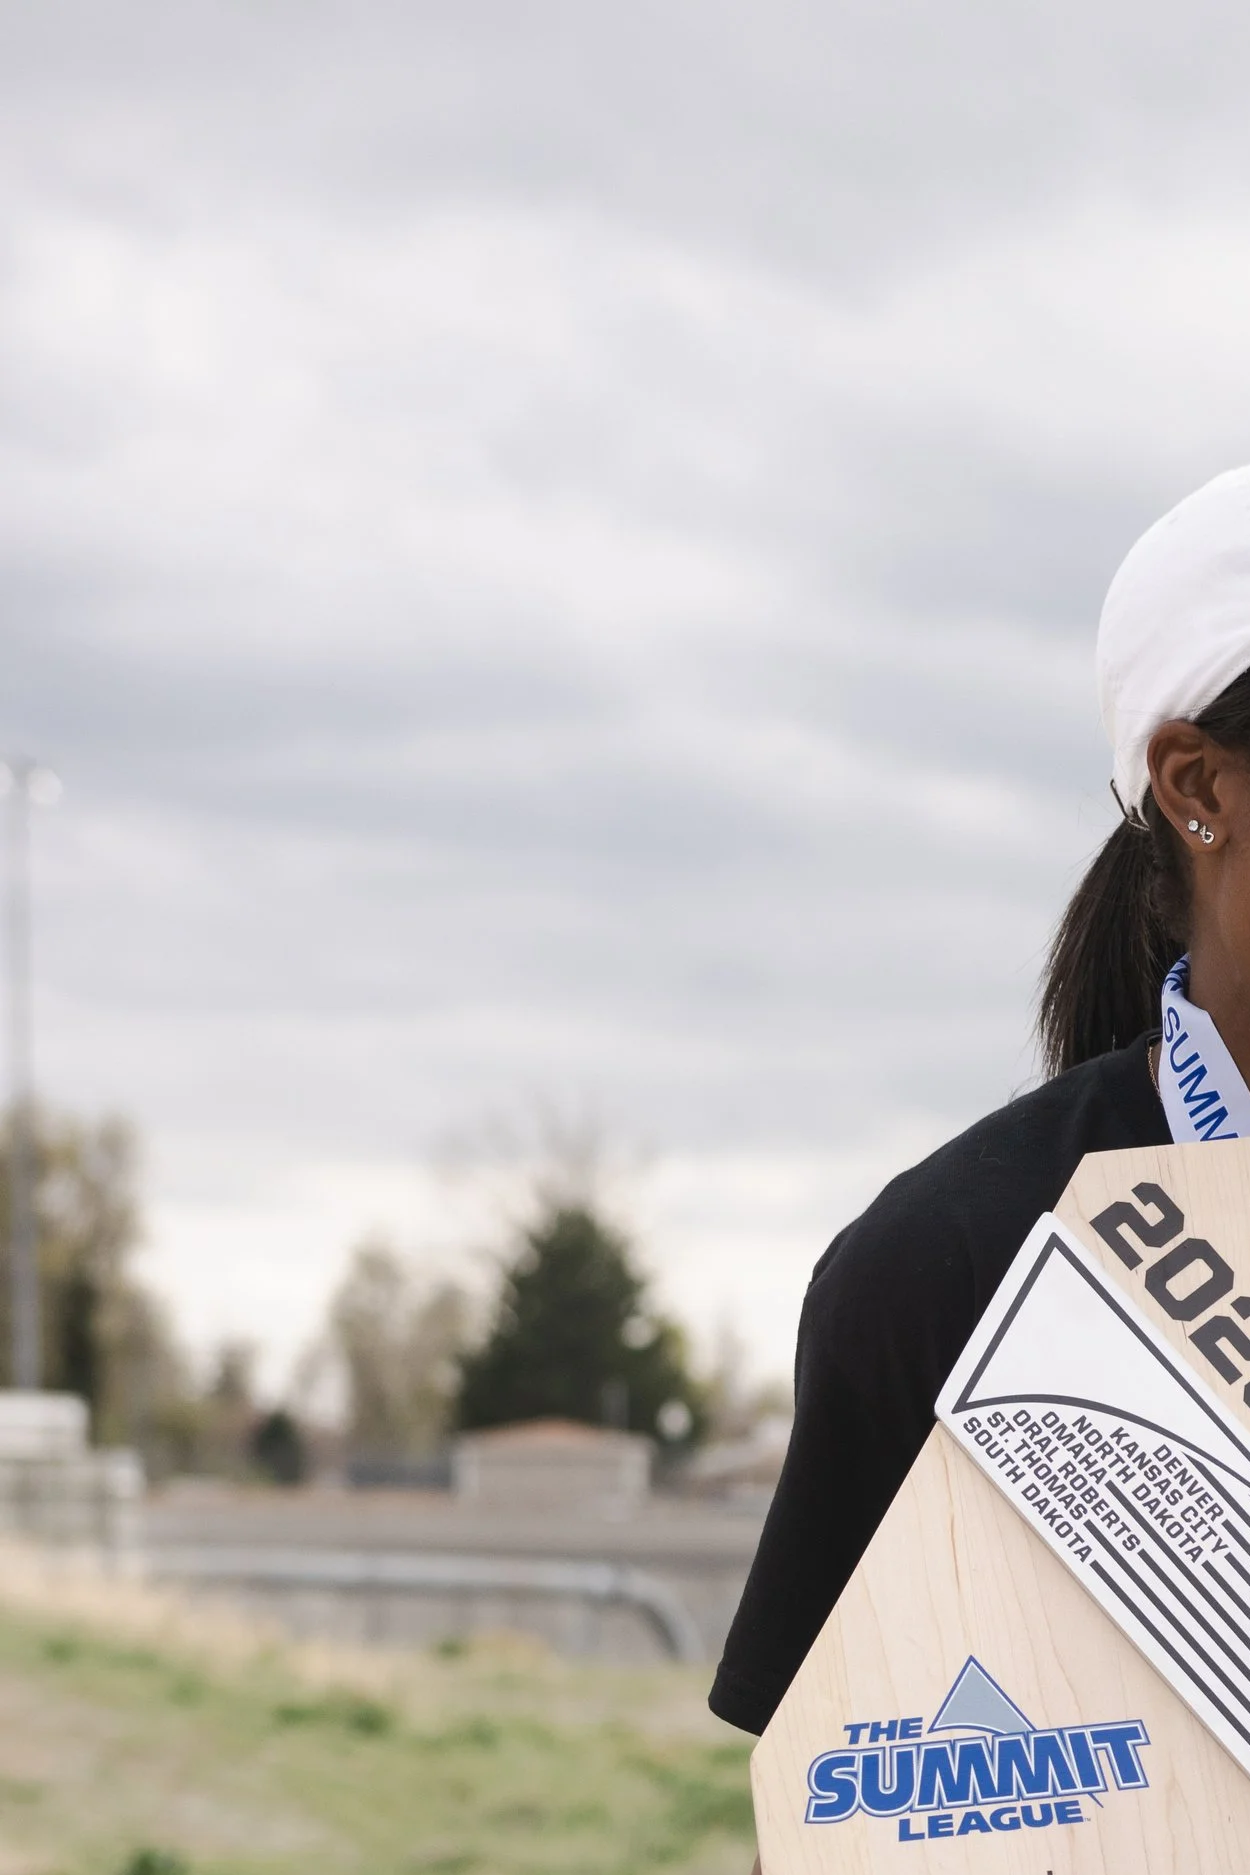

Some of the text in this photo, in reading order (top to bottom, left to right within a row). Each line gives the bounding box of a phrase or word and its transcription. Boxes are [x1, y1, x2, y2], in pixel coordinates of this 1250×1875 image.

[962, 1416, 1094, 1563] SOUTH DAKOTA
[986, 1411, 1088, 1521] ST. THOMAS
[1012, 1409, 1141, 1552] ORAL ROBERTS
[1040, 1411, 1107, 1485] OMAHA
[1071, 1415, 1204, 1563] NORTH DAKOTA
[1109, 1426, 1229, 1554] KANSAS CITY
[1152, 1444, 1224, 1521] DENVER
[804, 1719, 1152, 1824] SUMMIT
[843, 1717, 923, 1745] THE
[898, 1799, 1084, 1842] LEAGUE
